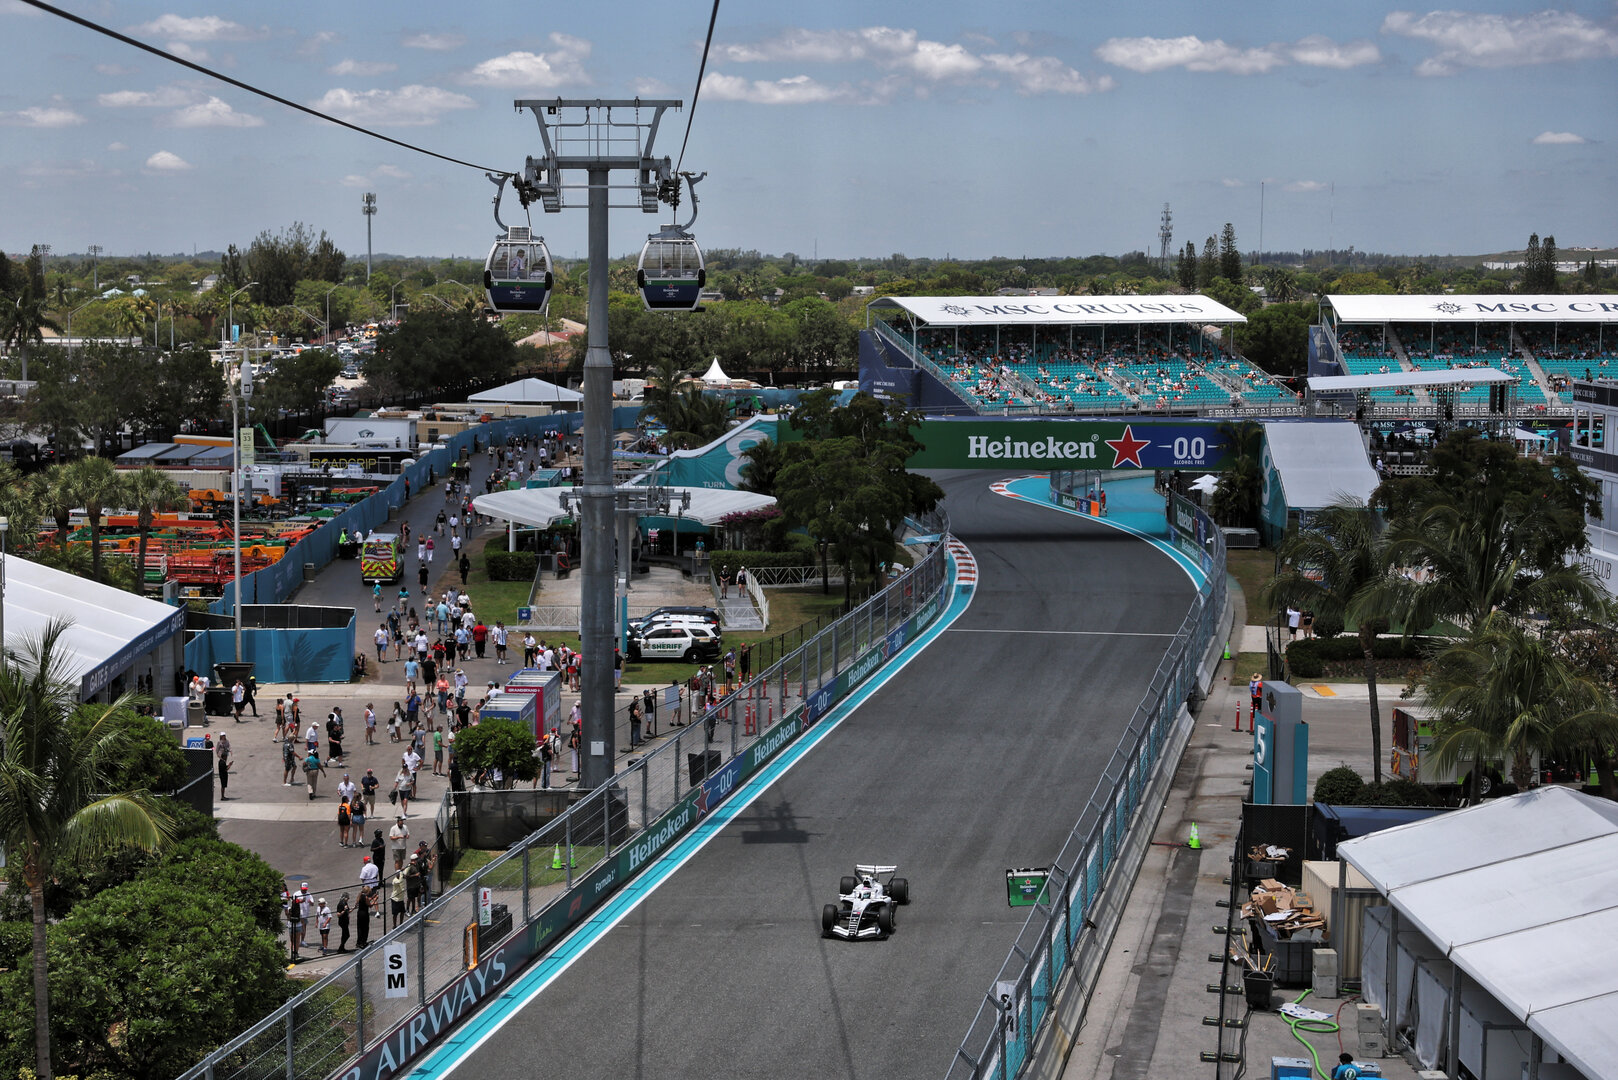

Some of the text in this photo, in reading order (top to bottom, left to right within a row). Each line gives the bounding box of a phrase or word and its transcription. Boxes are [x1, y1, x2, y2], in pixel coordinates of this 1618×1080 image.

[974, 303, 1204, 315] MSC CRUISES
[1473, 303, 1558, 313] MSC
[968, 436, 1097, 459] Heineken
[1174, 437, 1205, 459] 0.0
[1593, 558, 1612, 580] CLUB
[847, 651, 879, 688] Heineken
[754, 720, 796, 767] Heineken
[1256, 724, 1266, 764] 5
[628, 809, 690, 872] Heineken
[595, 872, 612, 893] Formula
[388, 954, 403, 970] S
[387, 973, 406, 990] M
[375, 948, 507, 1080] AIRWAYS
